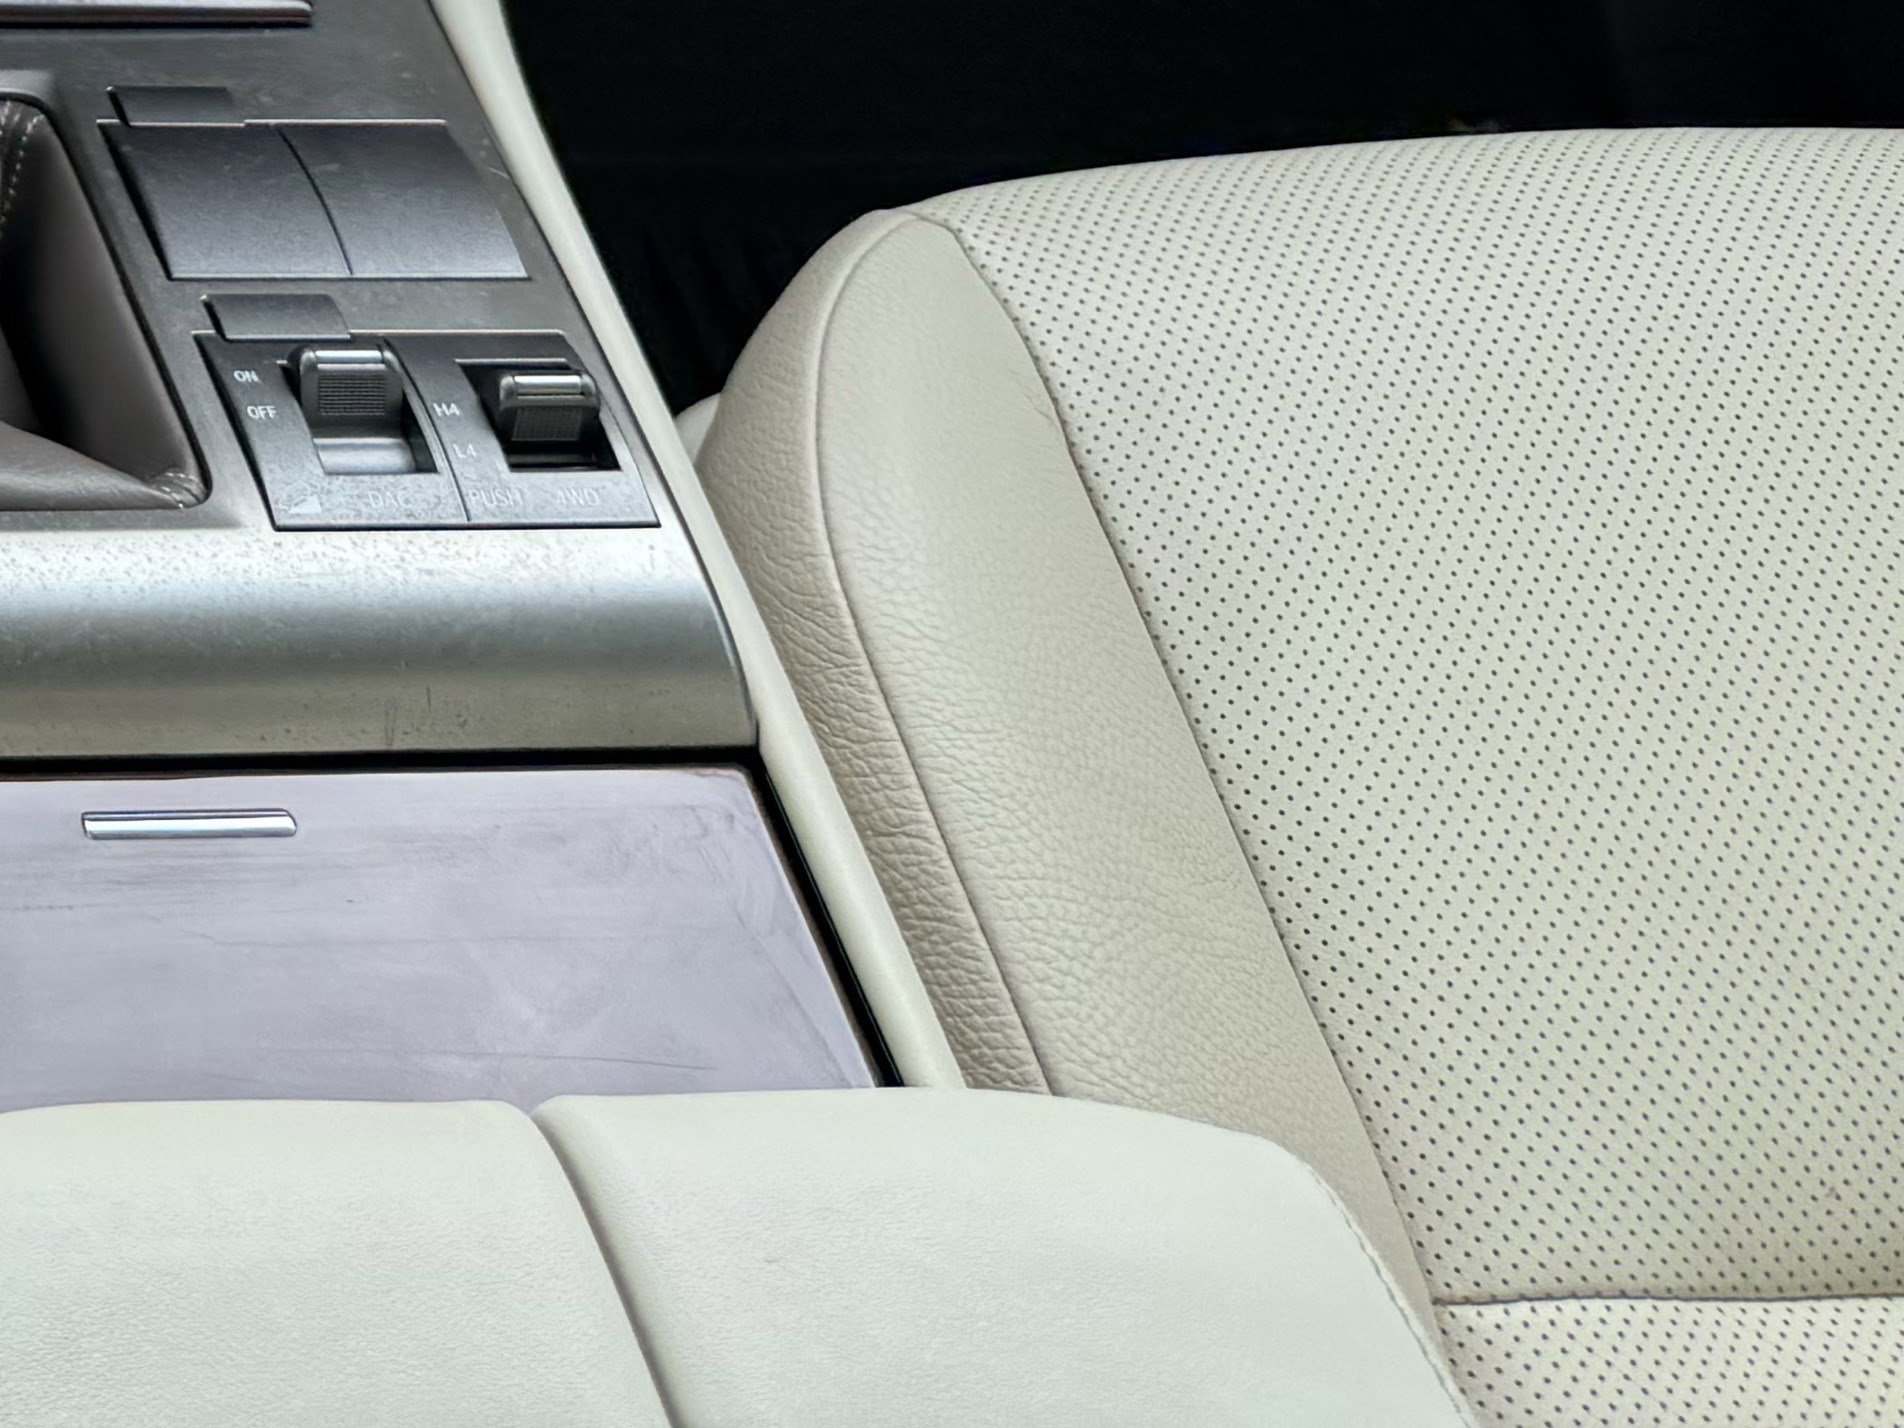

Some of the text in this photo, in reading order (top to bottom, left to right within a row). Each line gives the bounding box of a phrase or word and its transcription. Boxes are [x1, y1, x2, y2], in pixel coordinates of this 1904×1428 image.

[233, 370, 261, 384] ON
[246, 405, 278, 421] OFF
[432, 402, 462, 417] H4
[367, 491, 412, 509] DAC
[467, 490, 523, 507] PUSH
